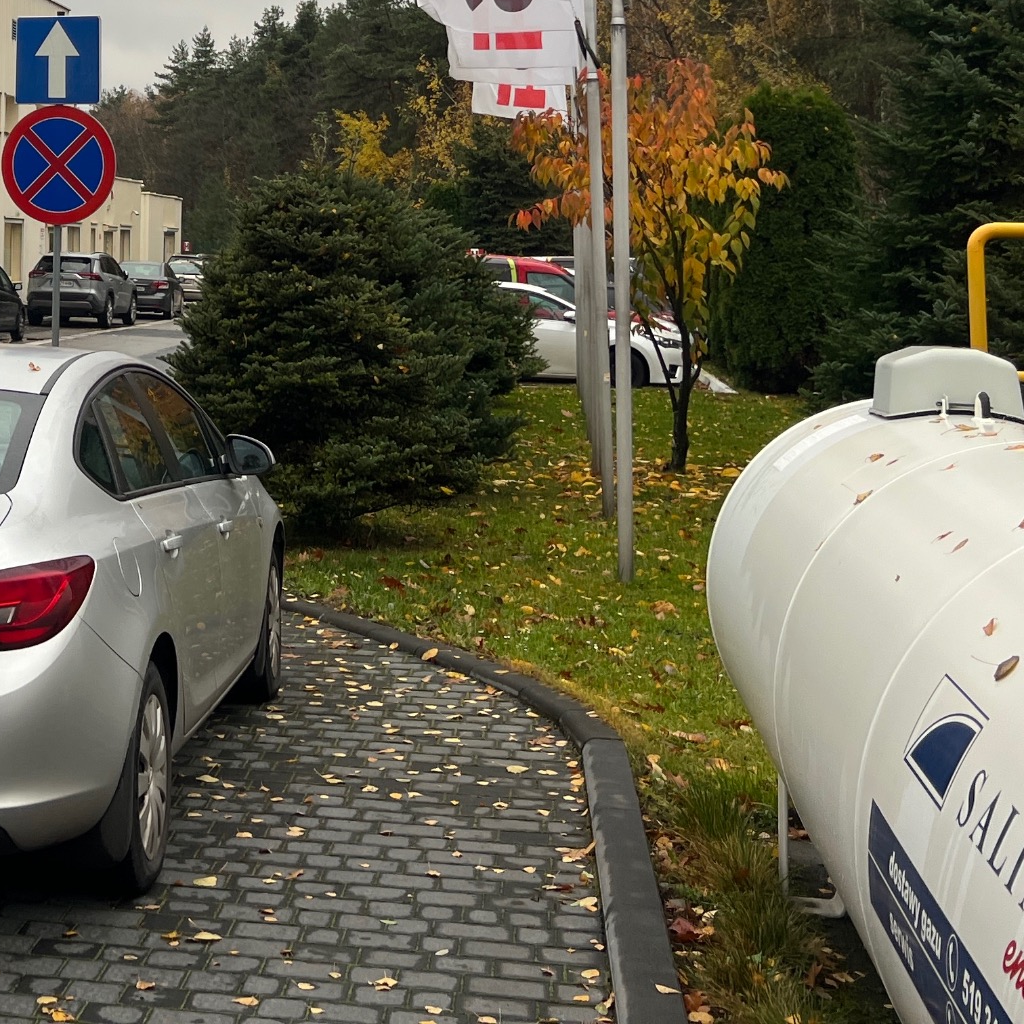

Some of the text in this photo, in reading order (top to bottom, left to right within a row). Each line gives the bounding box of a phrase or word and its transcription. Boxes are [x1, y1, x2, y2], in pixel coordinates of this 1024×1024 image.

[956, 769, 1024, 912] SALI
[889, 851, 921, 929] dostawy
[921, 909, 942, 961] gazu
[962, 968, 982, 1024] 519
[889, 912, 915, 972] serwis
